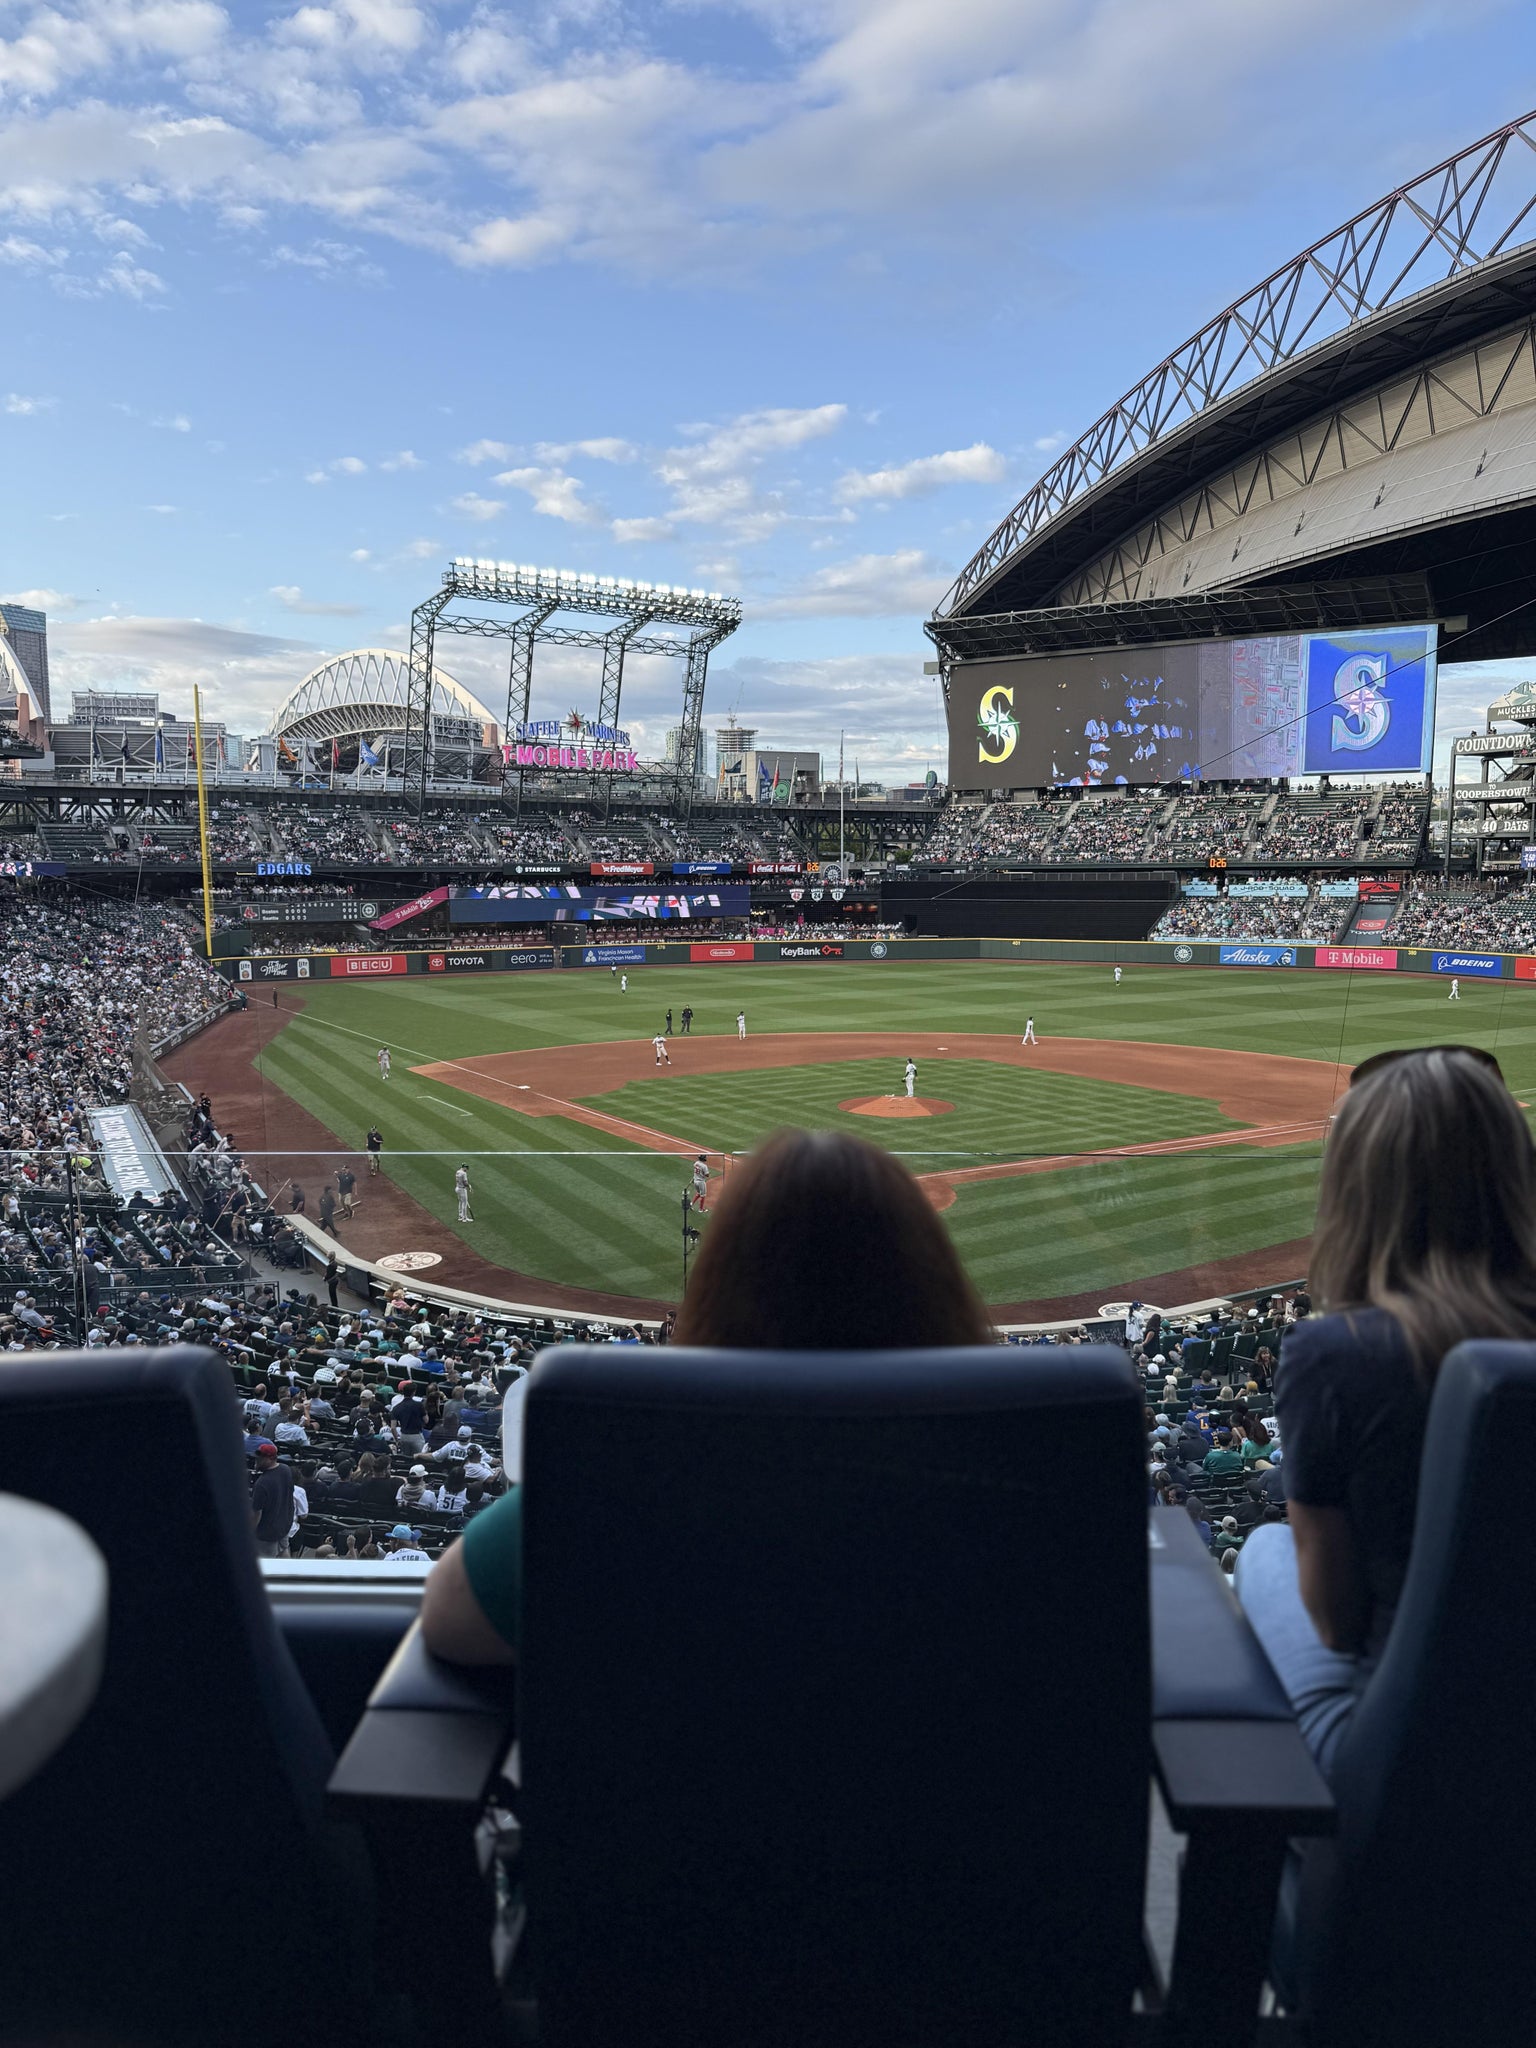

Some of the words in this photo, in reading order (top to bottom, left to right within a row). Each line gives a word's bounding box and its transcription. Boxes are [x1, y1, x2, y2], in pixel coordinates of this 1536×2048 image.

[516, 720, 560, 740] SEATTLE
[586, 721, 631, 747] MARINERS
[502, 745, 588, 769] T-MOBILE
[592, 749, 640, 770] PARK
[1482, 820, 1497, 833] 40
[1503, 820, 1529, 831] DAYS
[257, 863, 312, 876] EDGARS
[511, 954, 537, 964] eero
[597, 949, 616, 957] Virginia
[780, 947, 820, 958] KeyBank
[1223, 948, 1271, 964] Alaska
[1342, 952, 1384, 966] Mobile
[448, 957, 484, 966] TOYOTA
[1451, 958, 1494, 968] BOEING
[443, 1497, 455, 1510] 51
